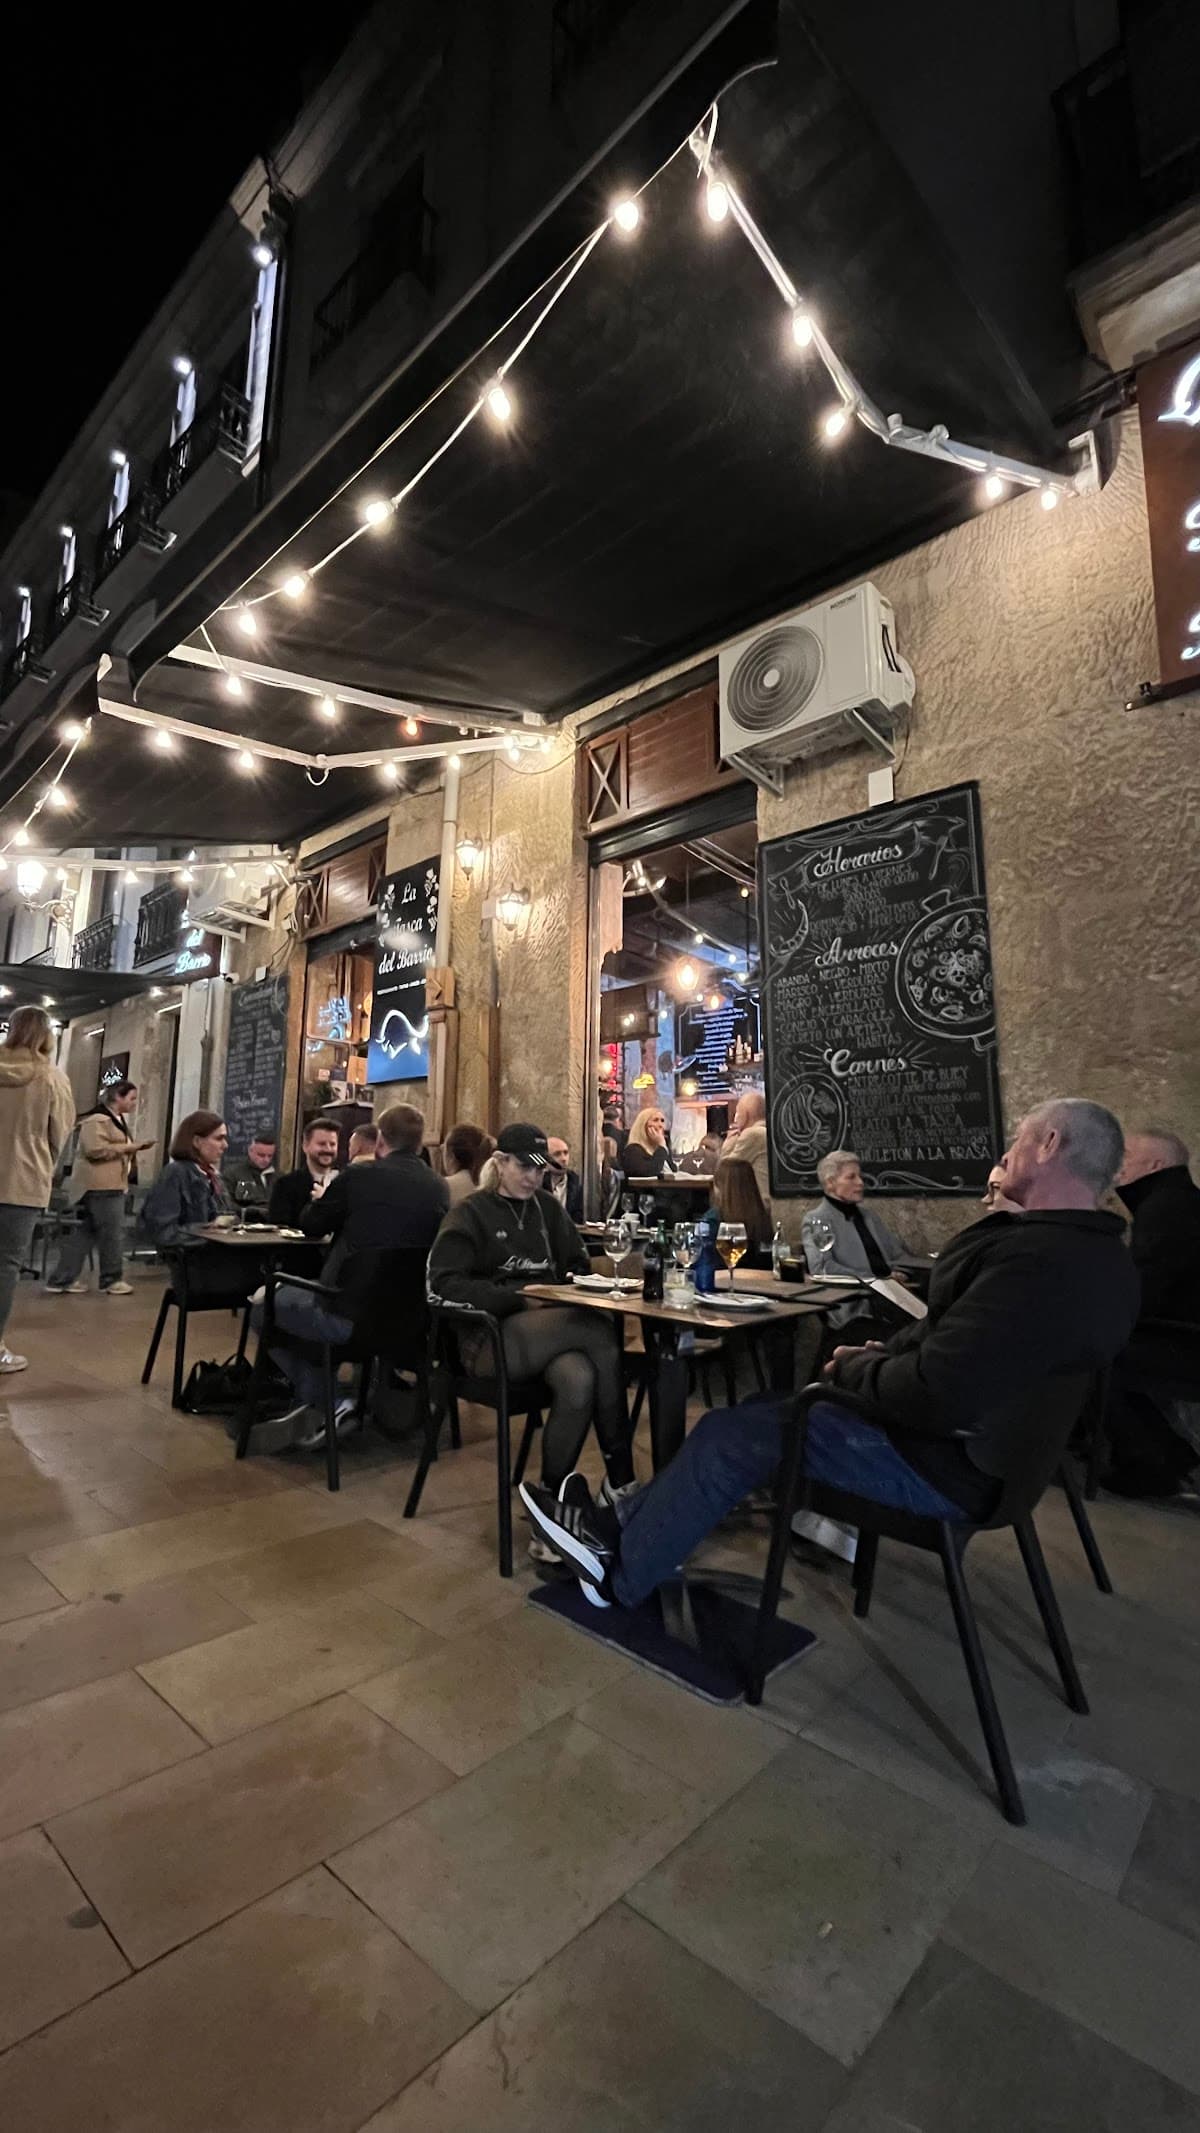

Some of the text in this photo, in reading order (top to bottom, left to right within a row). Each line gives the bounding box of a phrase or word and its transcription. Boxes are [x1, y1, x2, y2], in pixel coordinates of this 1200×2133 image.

[813, 844, 902, 877] Horarios
[401, 882, 417, 904] La
[378, 943, 433, 975] del Barrio
[815, 937, 898, 967] Arroces
[859, 960, 890, 975] MIXTO
[834, 972, 887, 990] VERDURAS
[829, 985, 884, 1003] VERDURAS
[824, 1048, 907, 1077] Carnes
